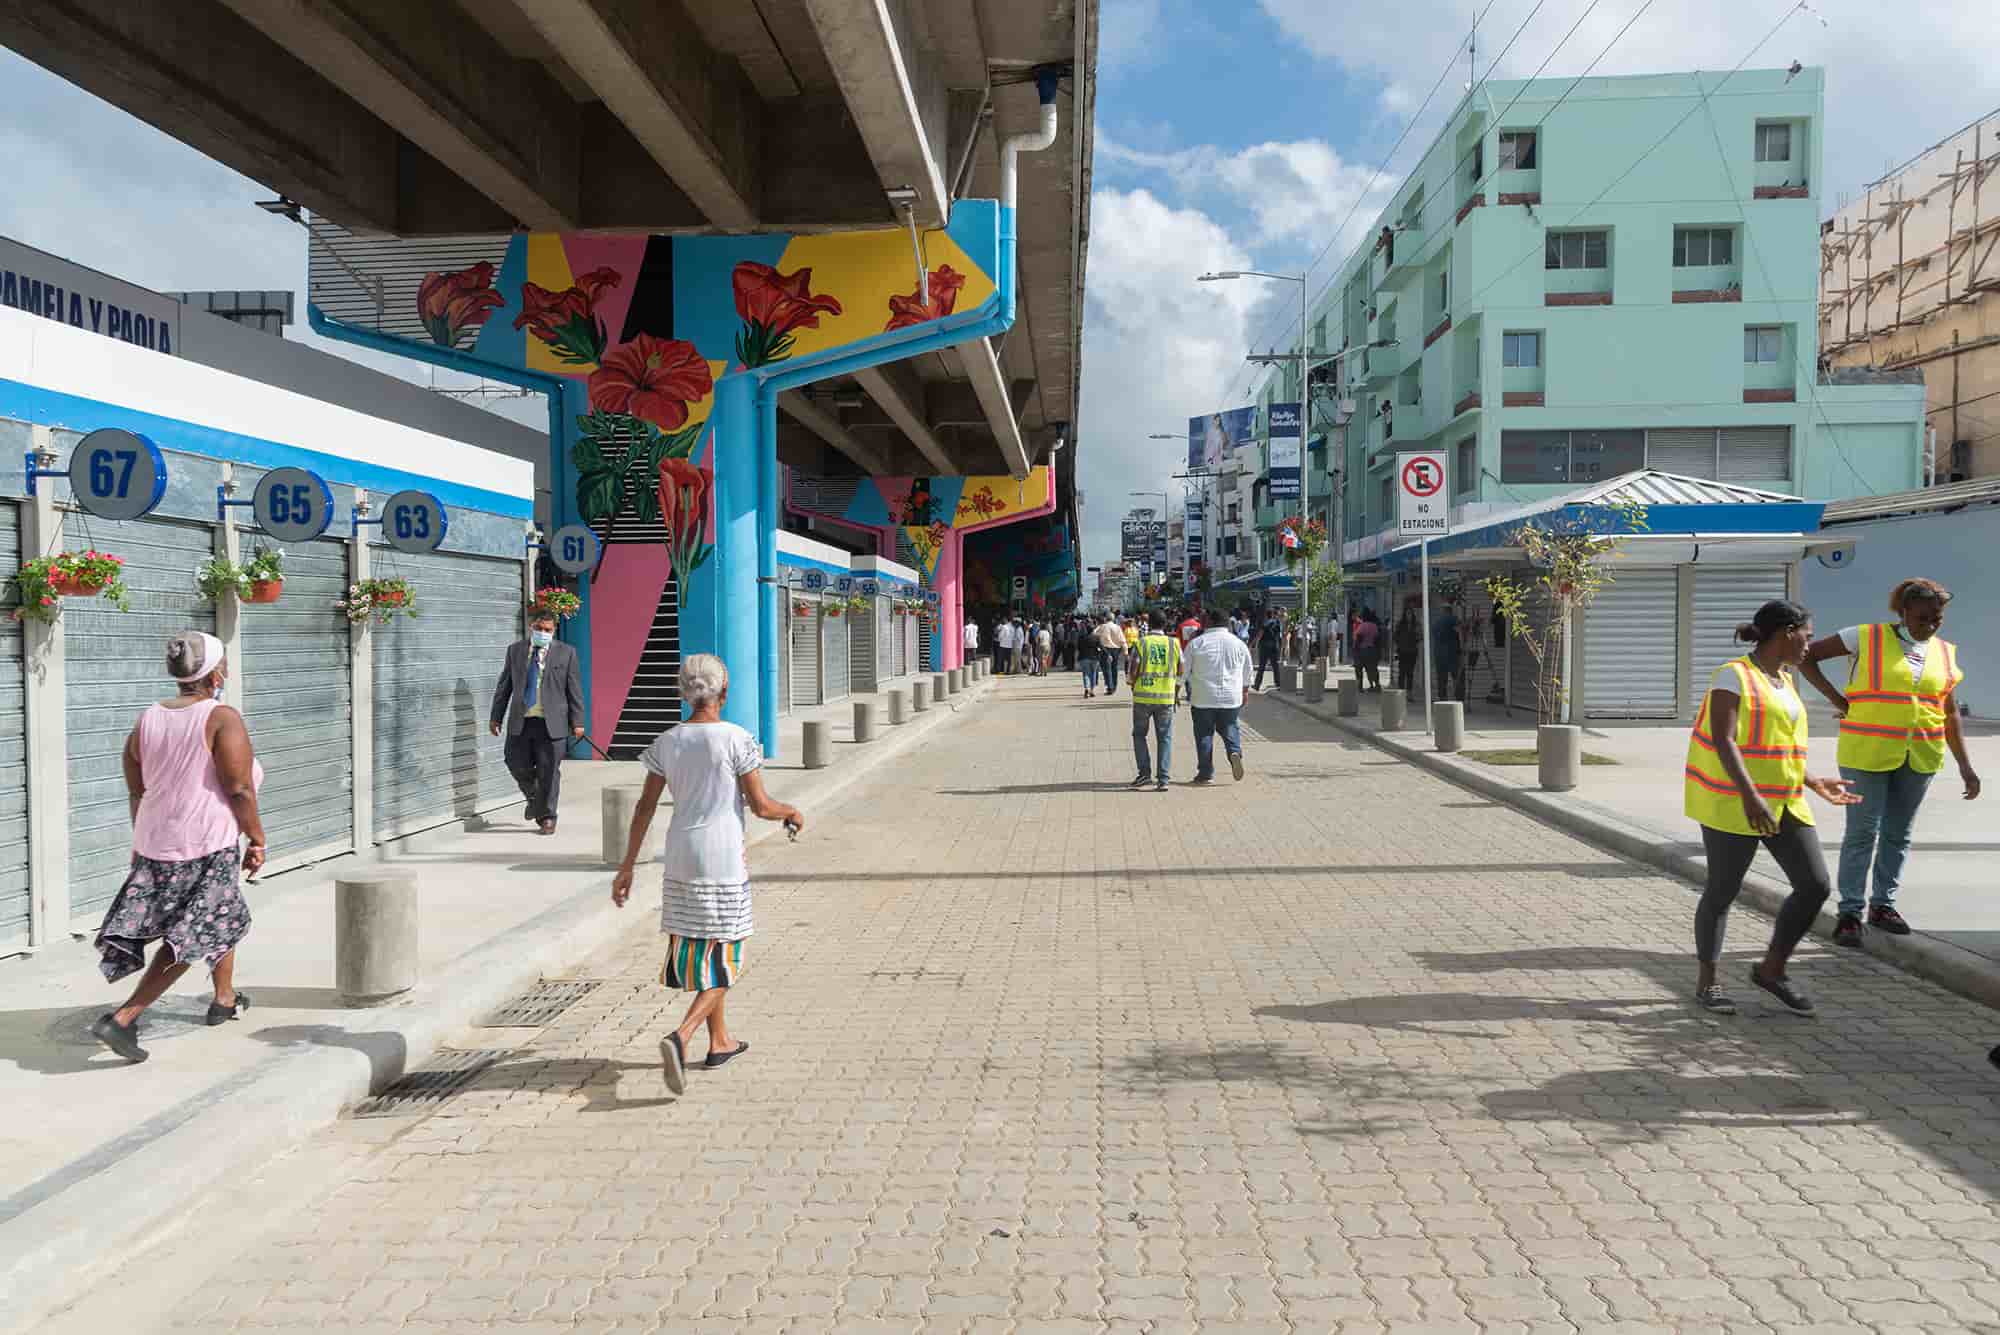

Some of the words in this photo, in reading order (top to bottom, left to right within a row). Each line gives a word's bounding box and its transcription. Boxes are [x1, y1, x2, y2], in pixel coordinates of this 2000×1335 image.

[88, 297, 103, 334] Y
[89, 448, 138, 499] 67
[268, 483, 312, 525] 65
[1417, 503, 1430, 513] NO
[394, 504, 430, 540] 63
[1402, 519, 1445, 529] ESTACIONE
[562, 534, 585, 562] 61
[807, 573, 822, 588] 59
